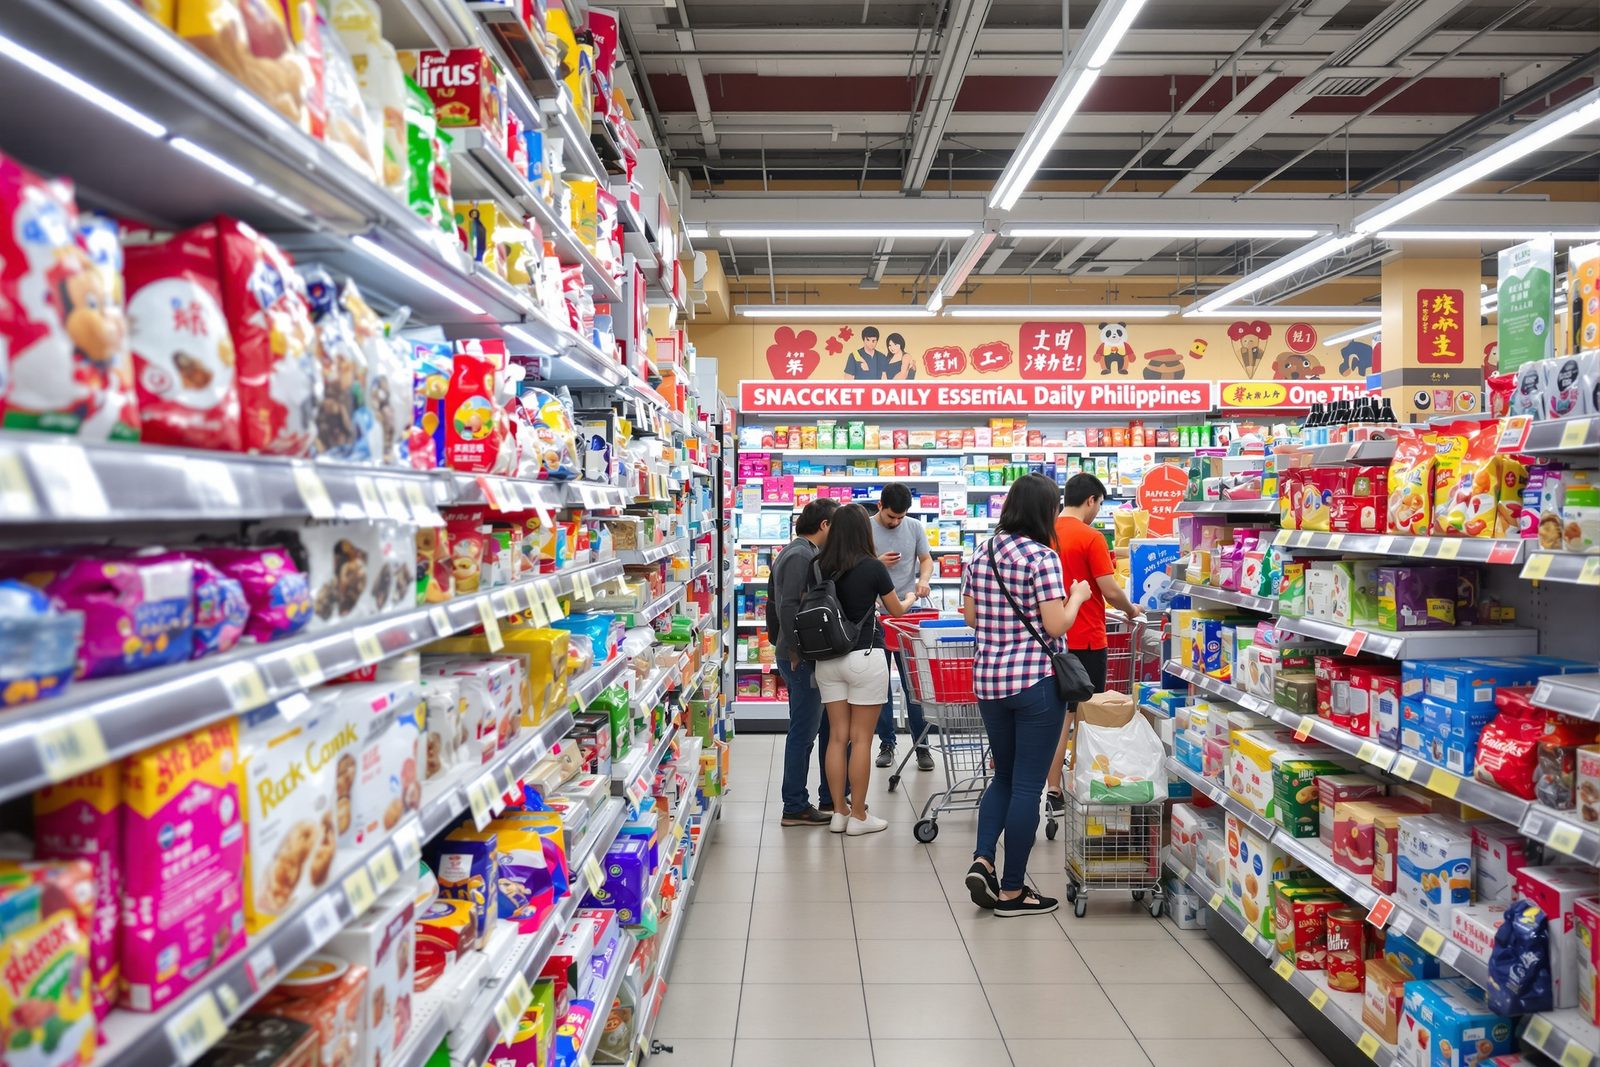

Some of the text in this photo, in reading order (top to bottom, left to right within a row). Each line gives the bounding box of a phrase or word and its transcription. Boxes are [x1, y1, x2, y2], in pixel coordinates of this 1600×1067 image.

[753, 387, 865, 406] SNACCKET
[871, 387, 930, 406] DAILY
[1034, 385, 1085, 409] Daily
[1091, 385, 1201, 408] Philippines
[1289, 386, 1328, 405] One
